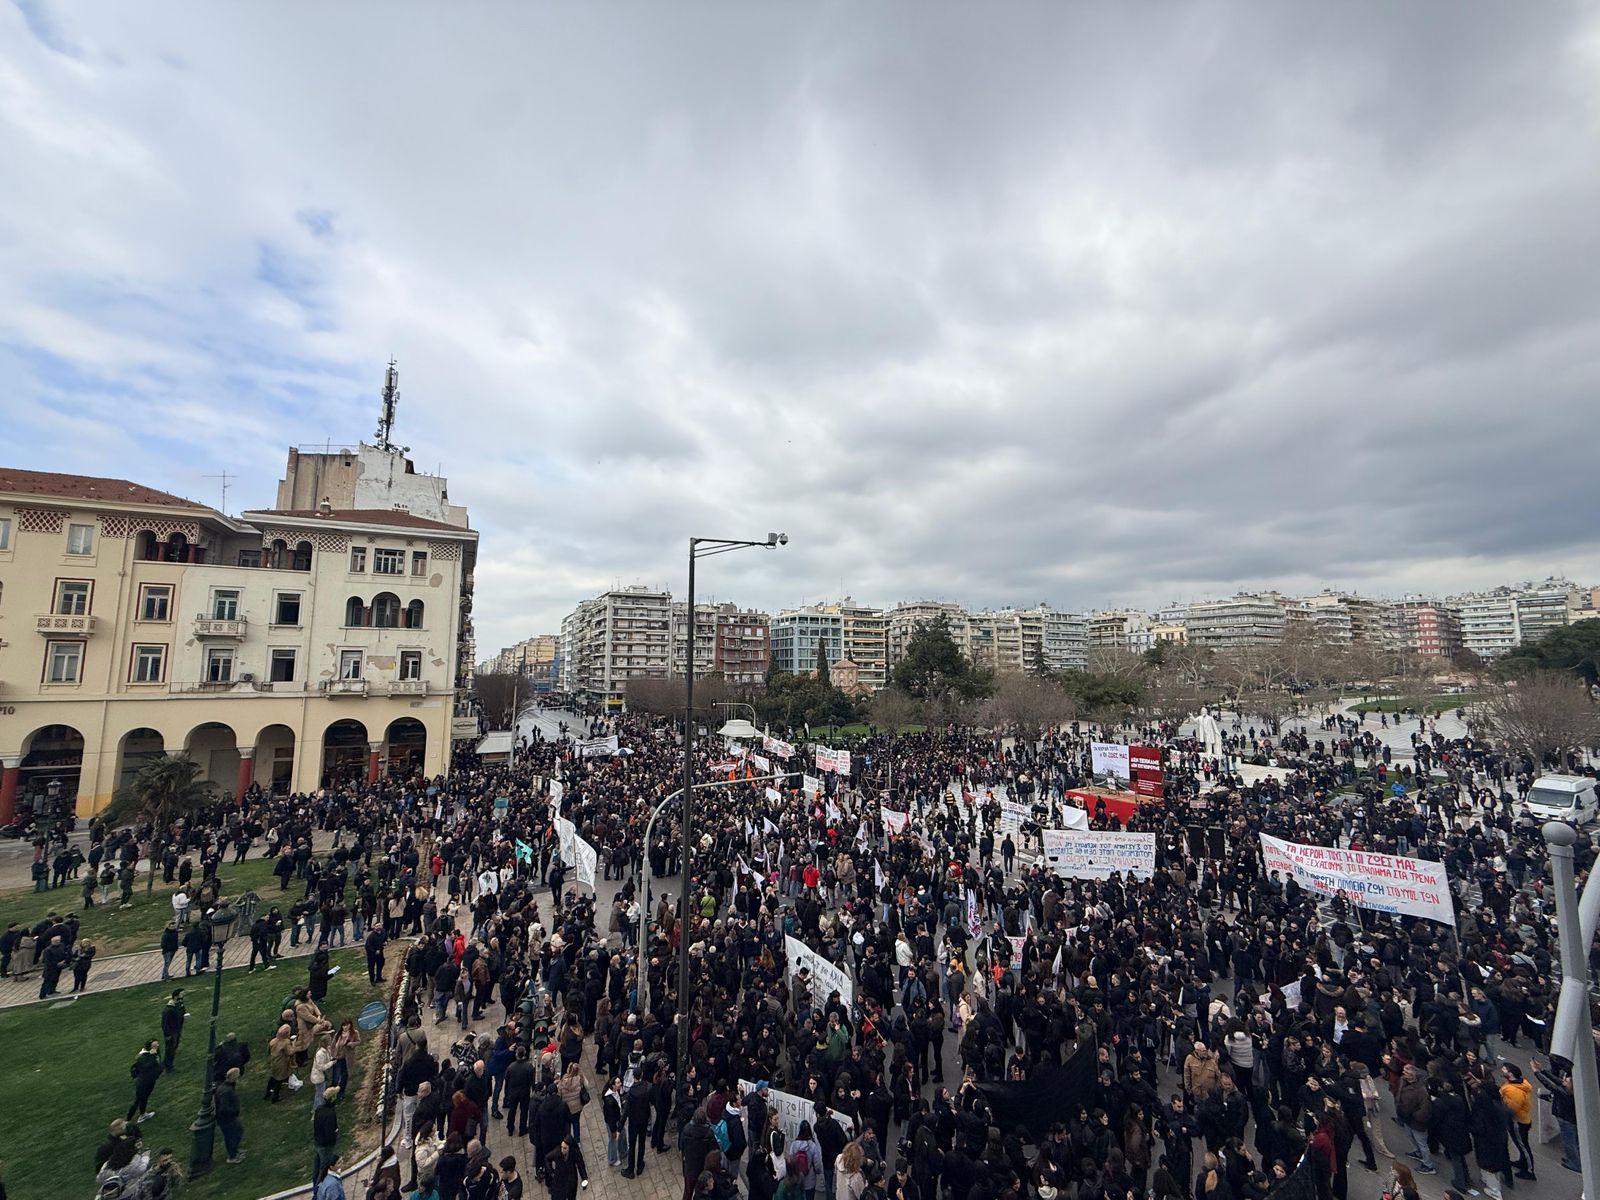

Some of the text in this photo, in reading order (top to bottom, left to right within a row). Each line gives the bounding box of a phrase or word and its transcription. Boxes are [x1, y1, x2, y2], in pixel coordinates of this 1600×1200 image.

[1285, 844, 1296, 853] ΤΑ
[1327, 850, 1343, 861] ΤΟΥΣ
[1356, 853, 1364, 864] ΟΙ
[1367, 855, 1393, 868] ΖΩΕΣ
[1396, 858, 1417, 872] ΜΑΣ
[1347, 864, 1356, 872] ΤΟ
[1358, 865, 1392, 878] ΕΓΚΛΗΜΑ
[1394, 870, 1408, 880] ΣΤΑ
[1410, 872, 1436, 885] ΤΡΕΝΑ
[1347, 891, 1366, 903] ΜΑΣ
[1367, 883, 1384, 895] ΖΩΗ
[1386, 886, 1400, 897] ΣΤΟ
[1419, 891, 1440, 904] ΤΩΝ
